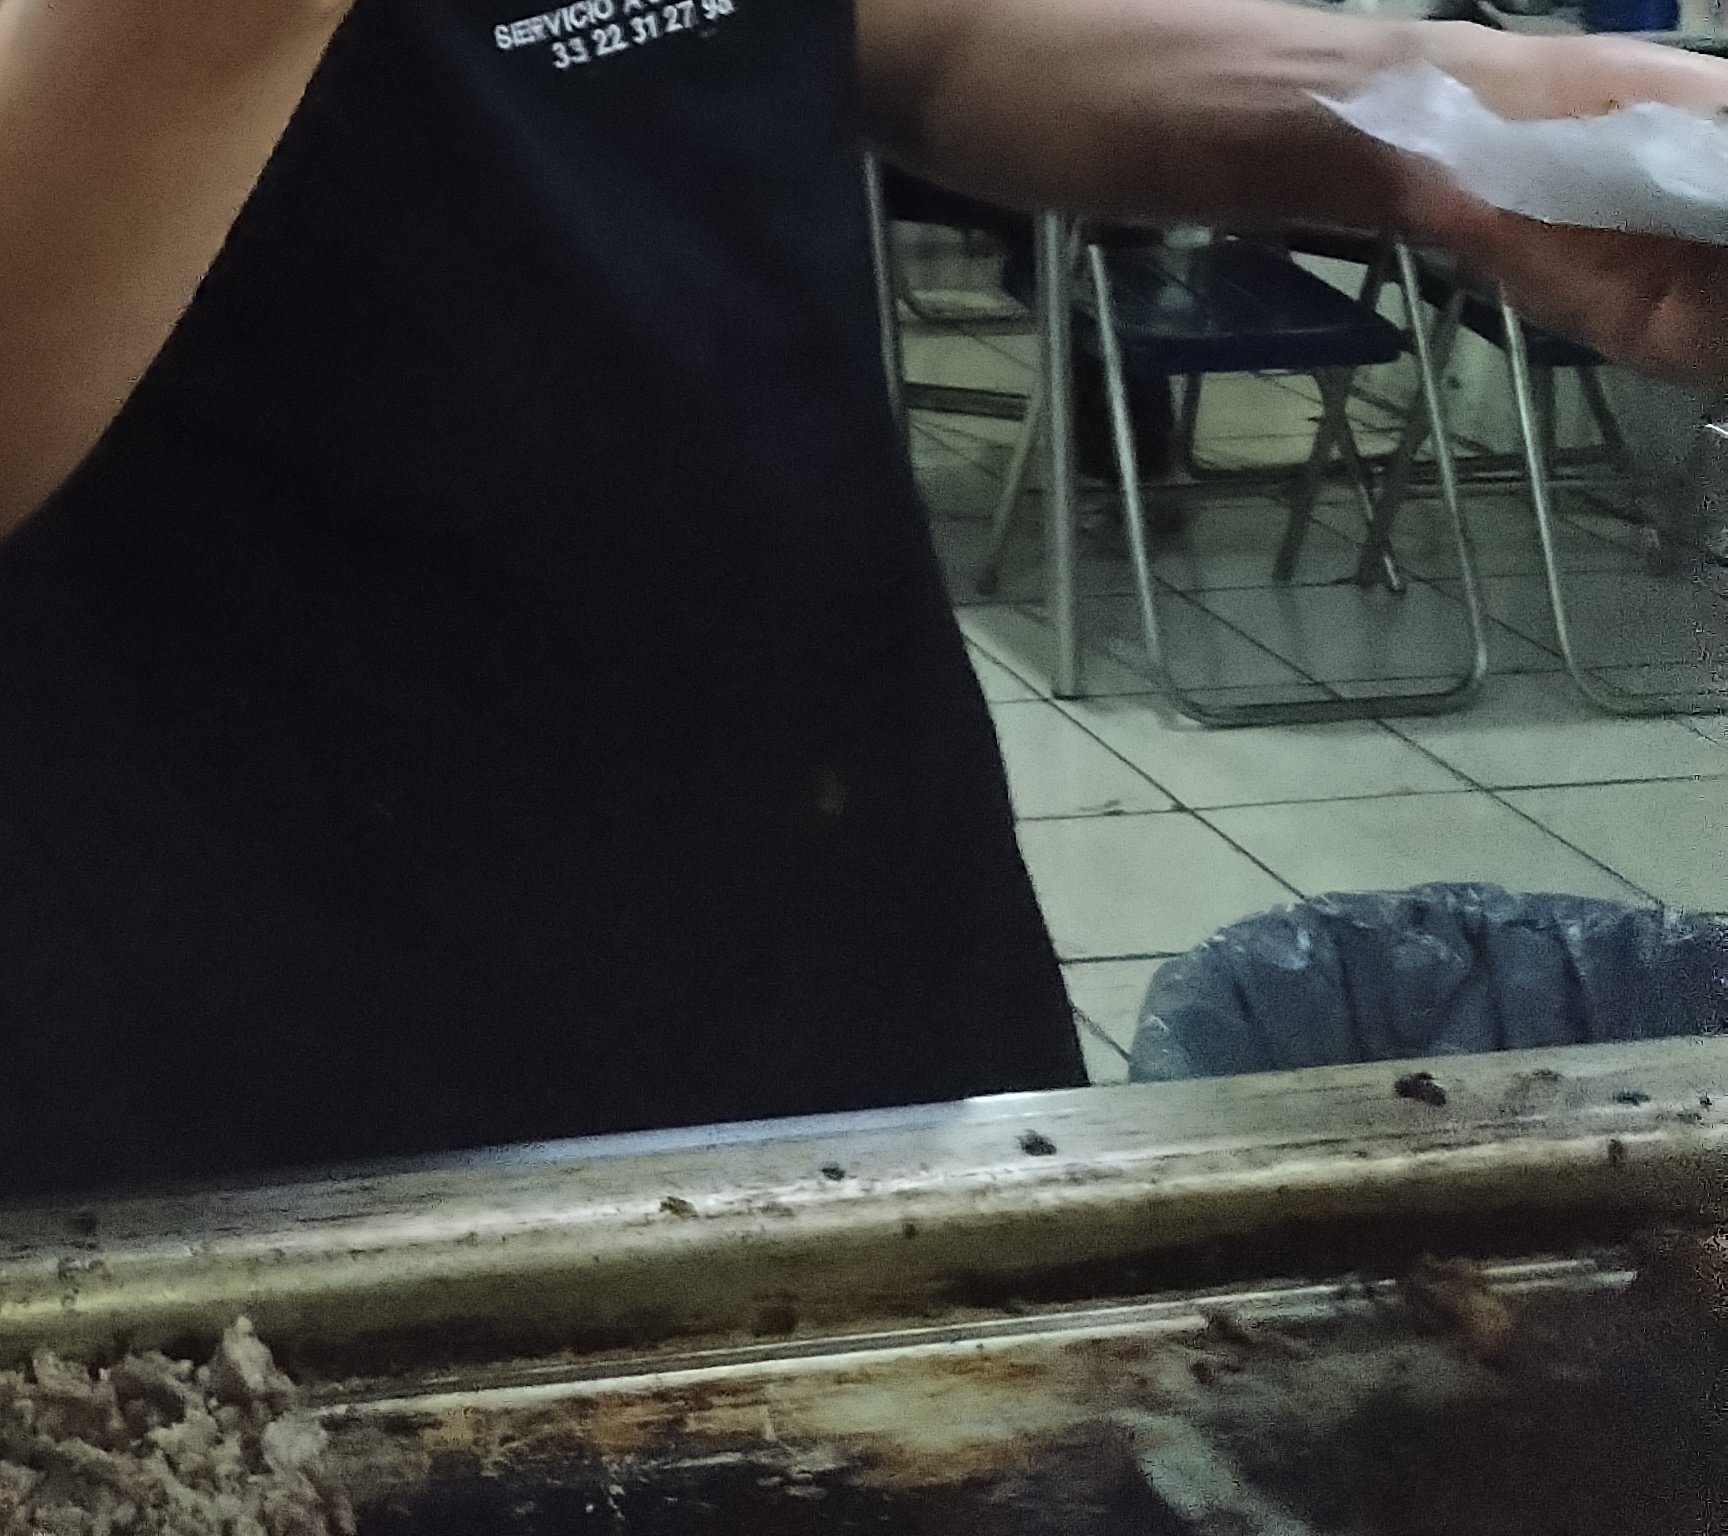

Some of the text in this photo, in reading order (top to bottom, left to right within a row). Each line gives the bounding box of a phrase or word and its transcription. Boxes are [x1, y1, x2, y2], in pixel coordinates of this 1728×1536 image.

[552, 36, 589, 69] 33
[592, 23, 629, 56] 22
[629, 11, 659, 44] 31
[662, 0, 696, 32] 27
